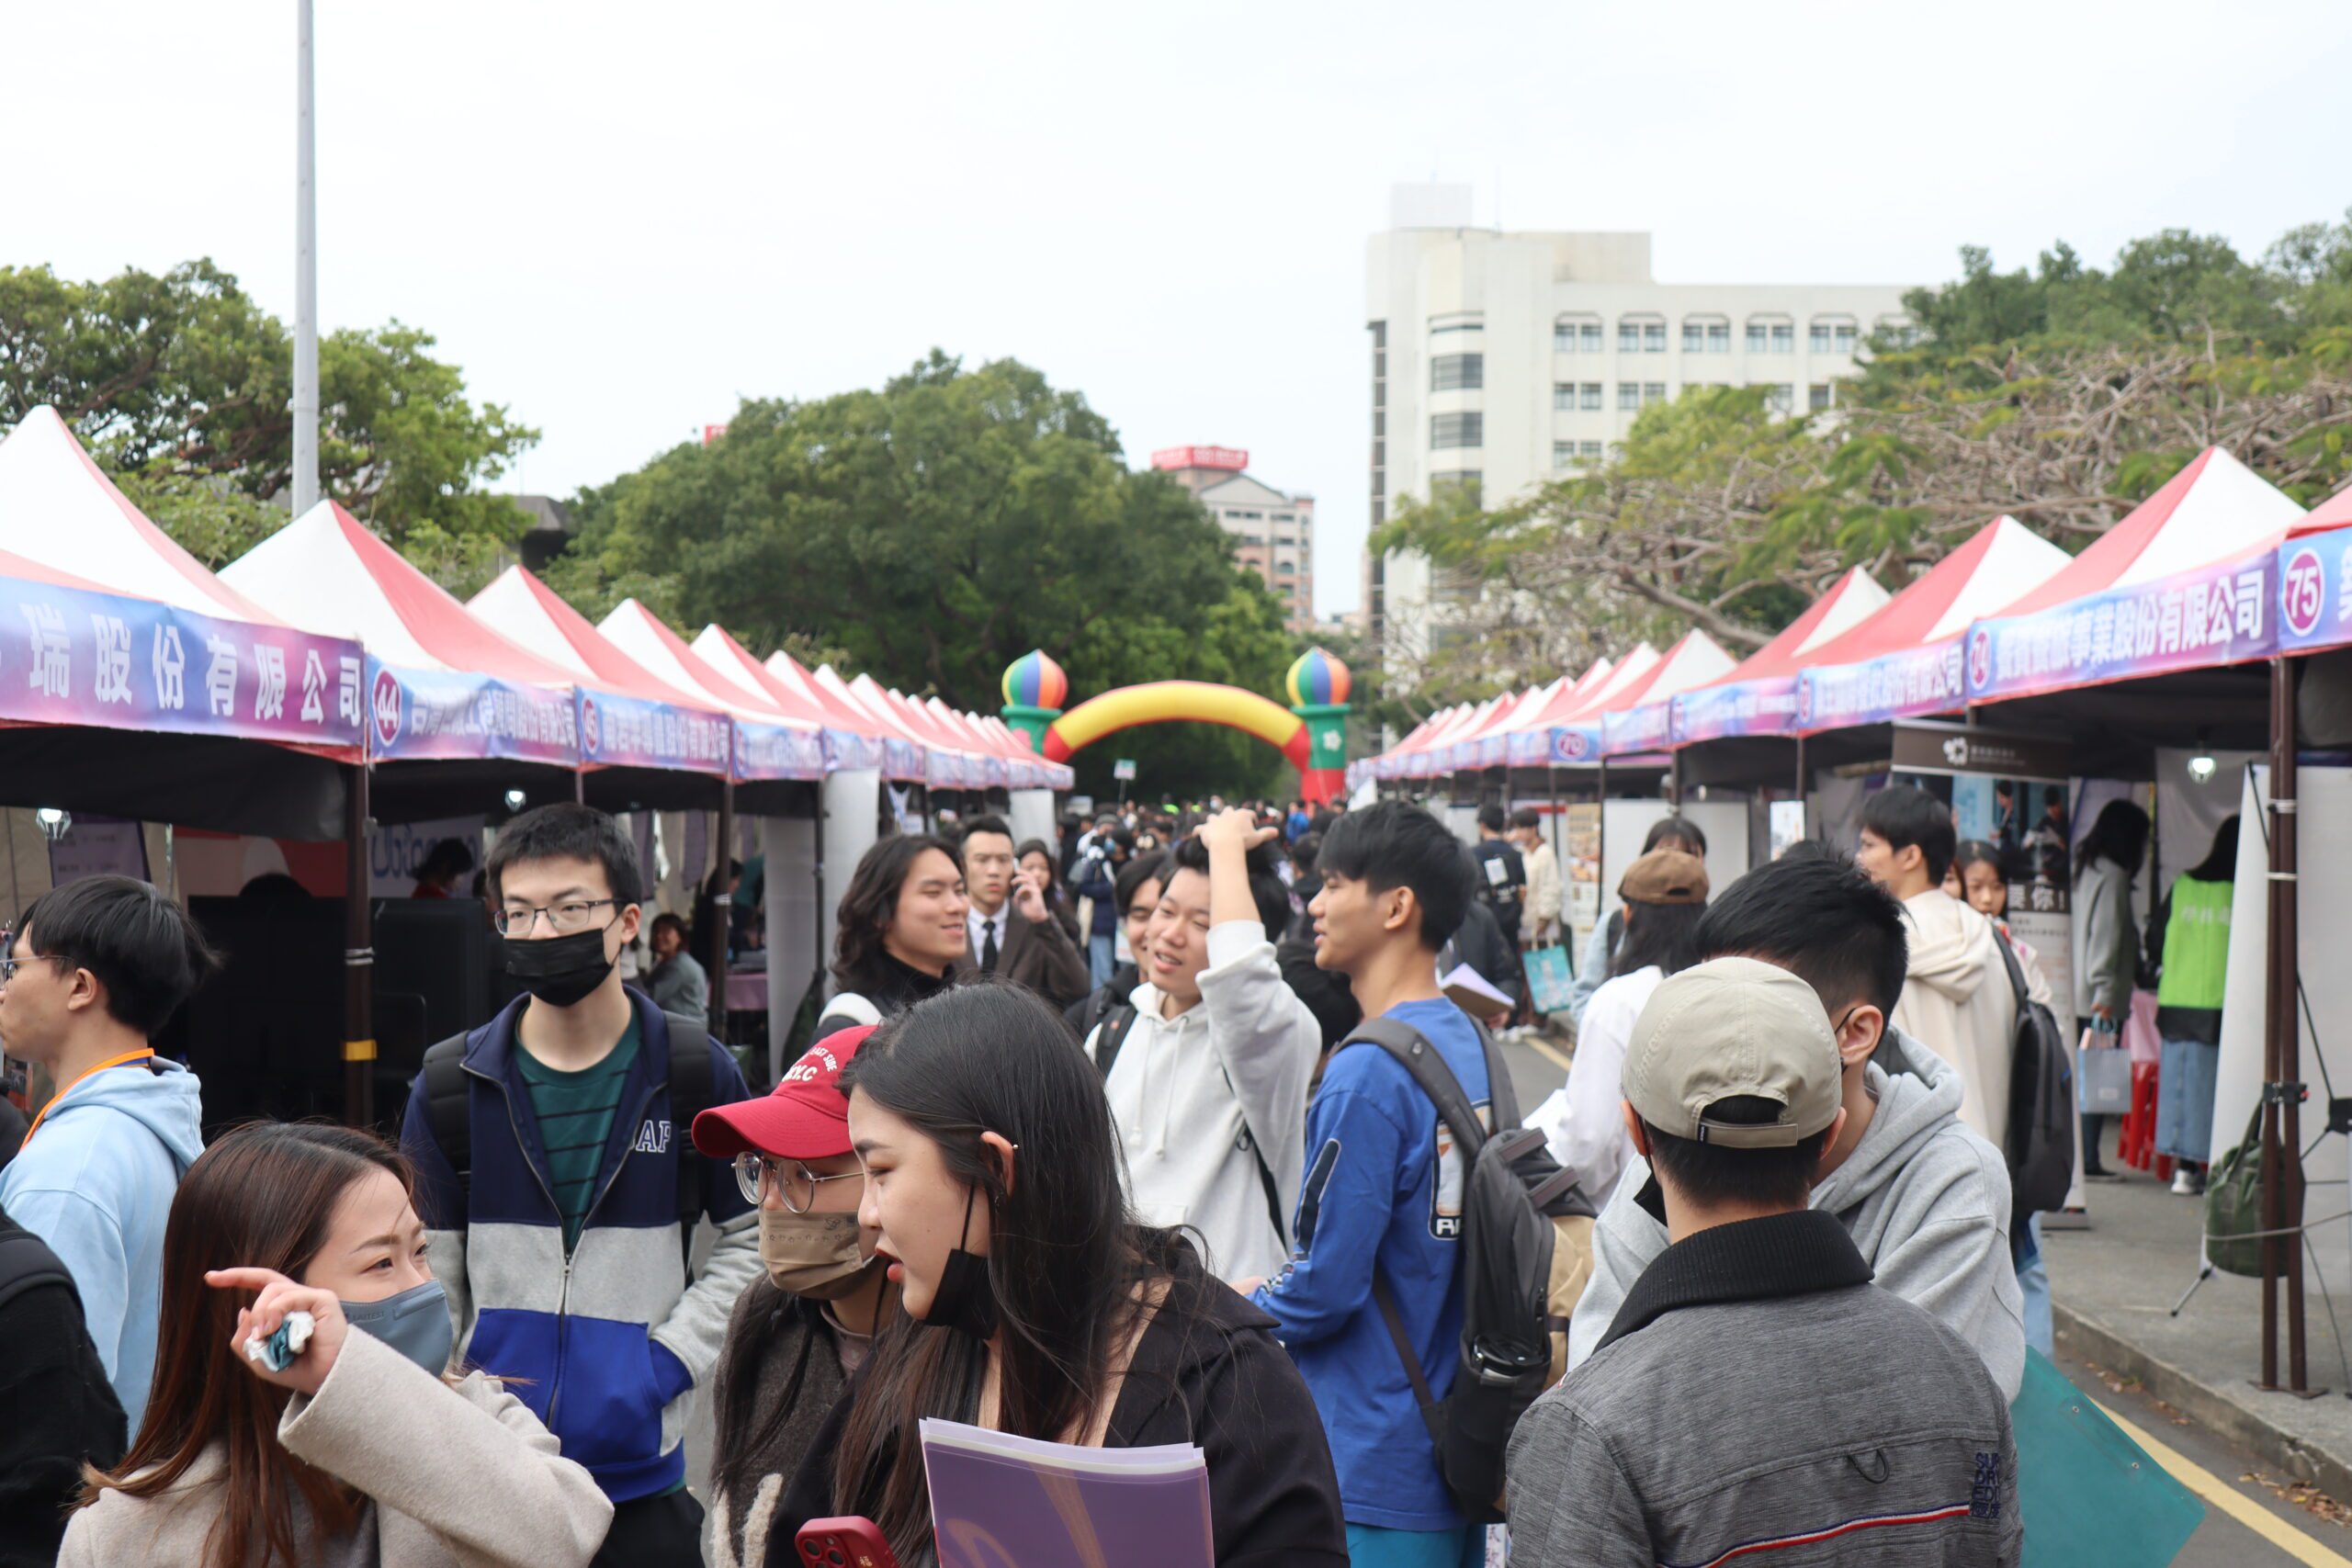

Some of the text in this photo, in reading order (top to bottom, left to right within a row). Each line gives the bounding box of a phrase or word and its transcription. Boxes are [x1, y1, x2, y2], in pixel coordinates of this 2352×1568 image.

[2288, 565, 2318, 619] 75
[19, 604, 362, 727] 瑞股份有限公司
[377, 683, 399, 729] 44
